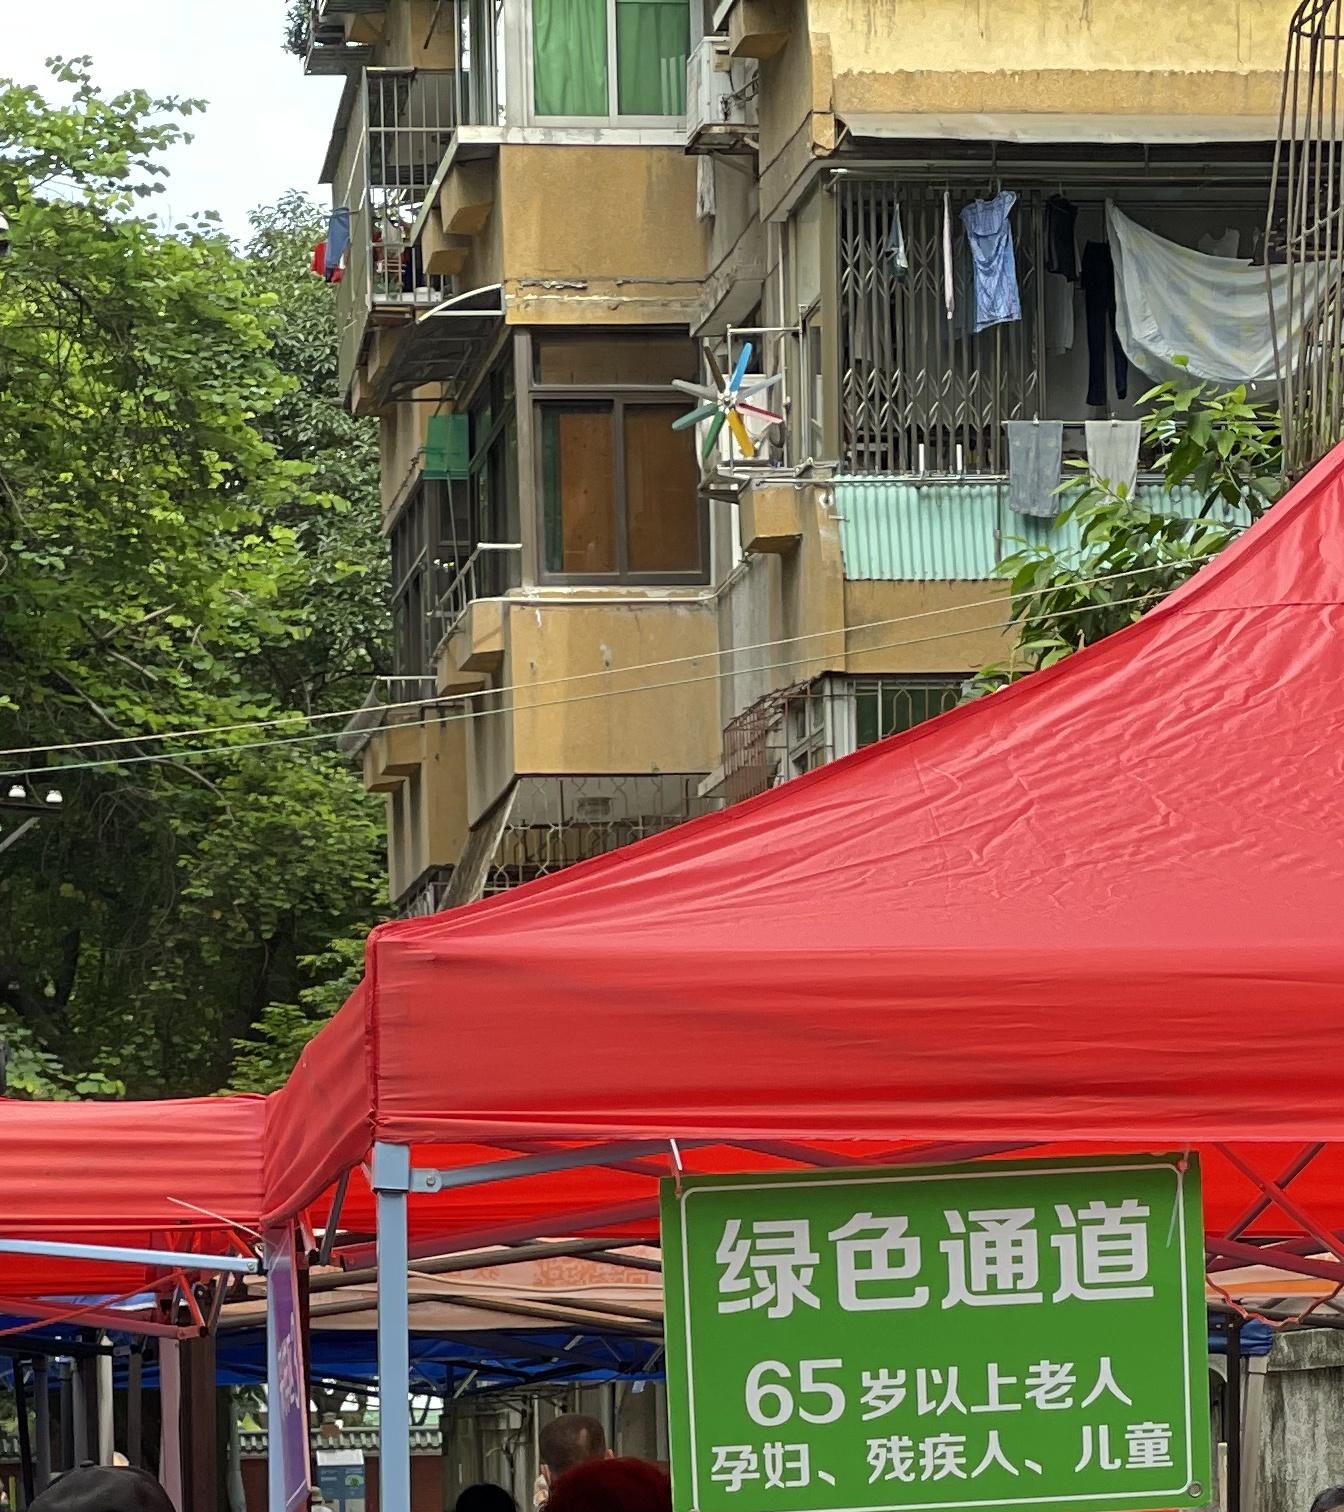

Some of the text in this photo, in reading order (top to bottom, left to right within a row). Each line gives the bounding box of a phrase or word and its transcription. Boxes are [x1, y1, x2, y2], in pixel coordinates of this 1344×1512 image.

[715, 1199, 1155, 1319] 绿色通道
[711, 1421, 1174, 1493] 孕妇、残疾人、儿童
